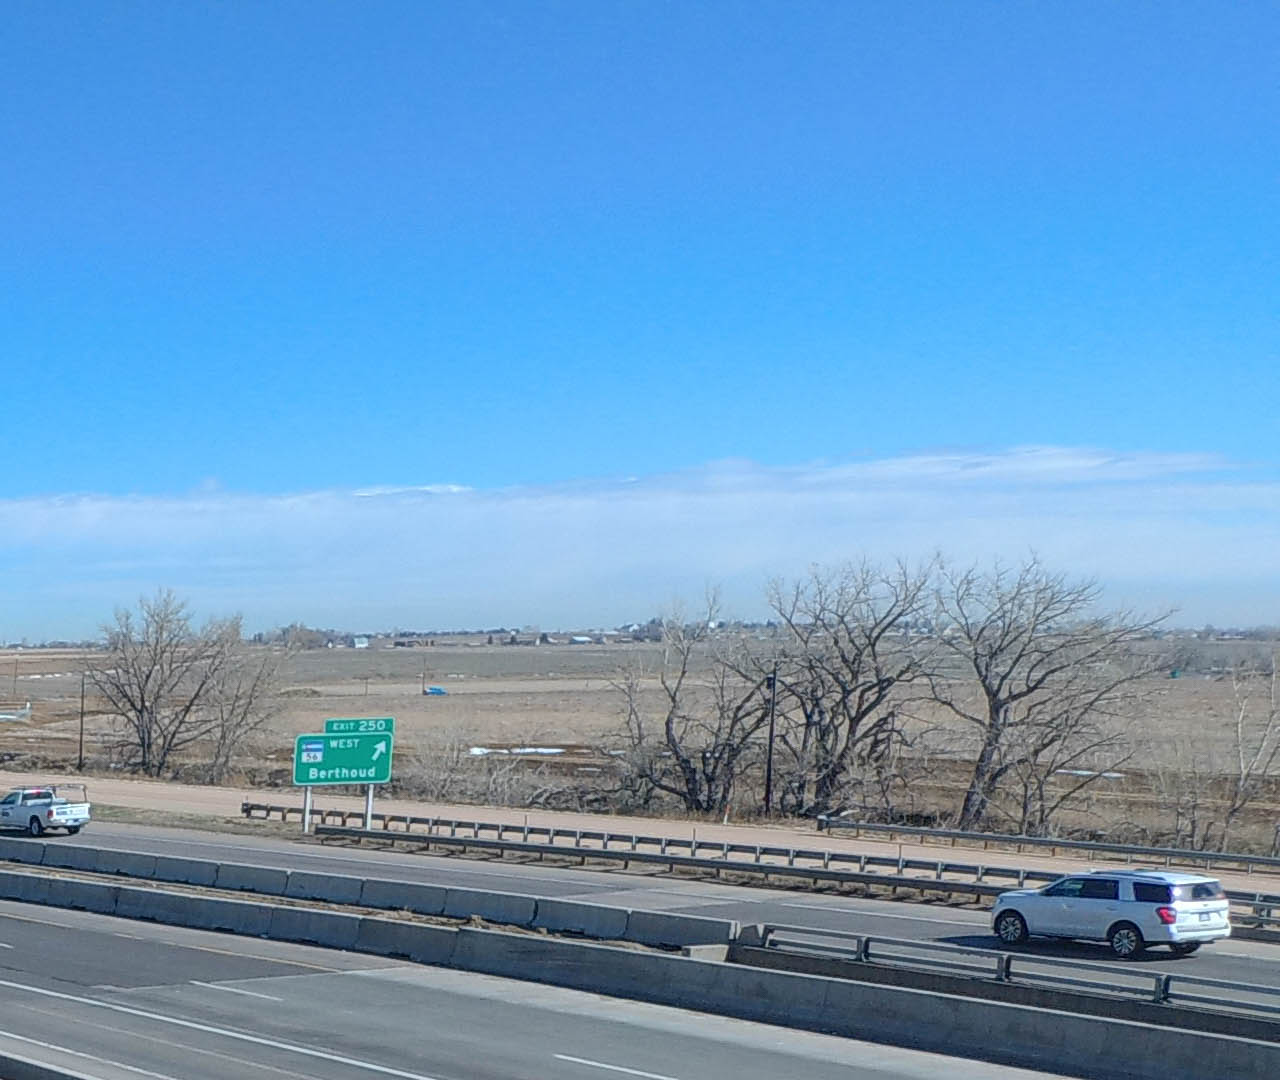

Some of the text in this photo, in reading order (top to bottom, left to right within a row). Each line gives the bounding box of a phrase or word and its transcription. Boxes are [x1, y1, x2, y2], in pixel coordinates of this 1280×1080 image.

[332, 720, 386, 732] EXIT 250
[329, 738, 360, 749] WEST
[306, 752, 319, 761] 56
[308, 766, 376, 780] Berthoud
